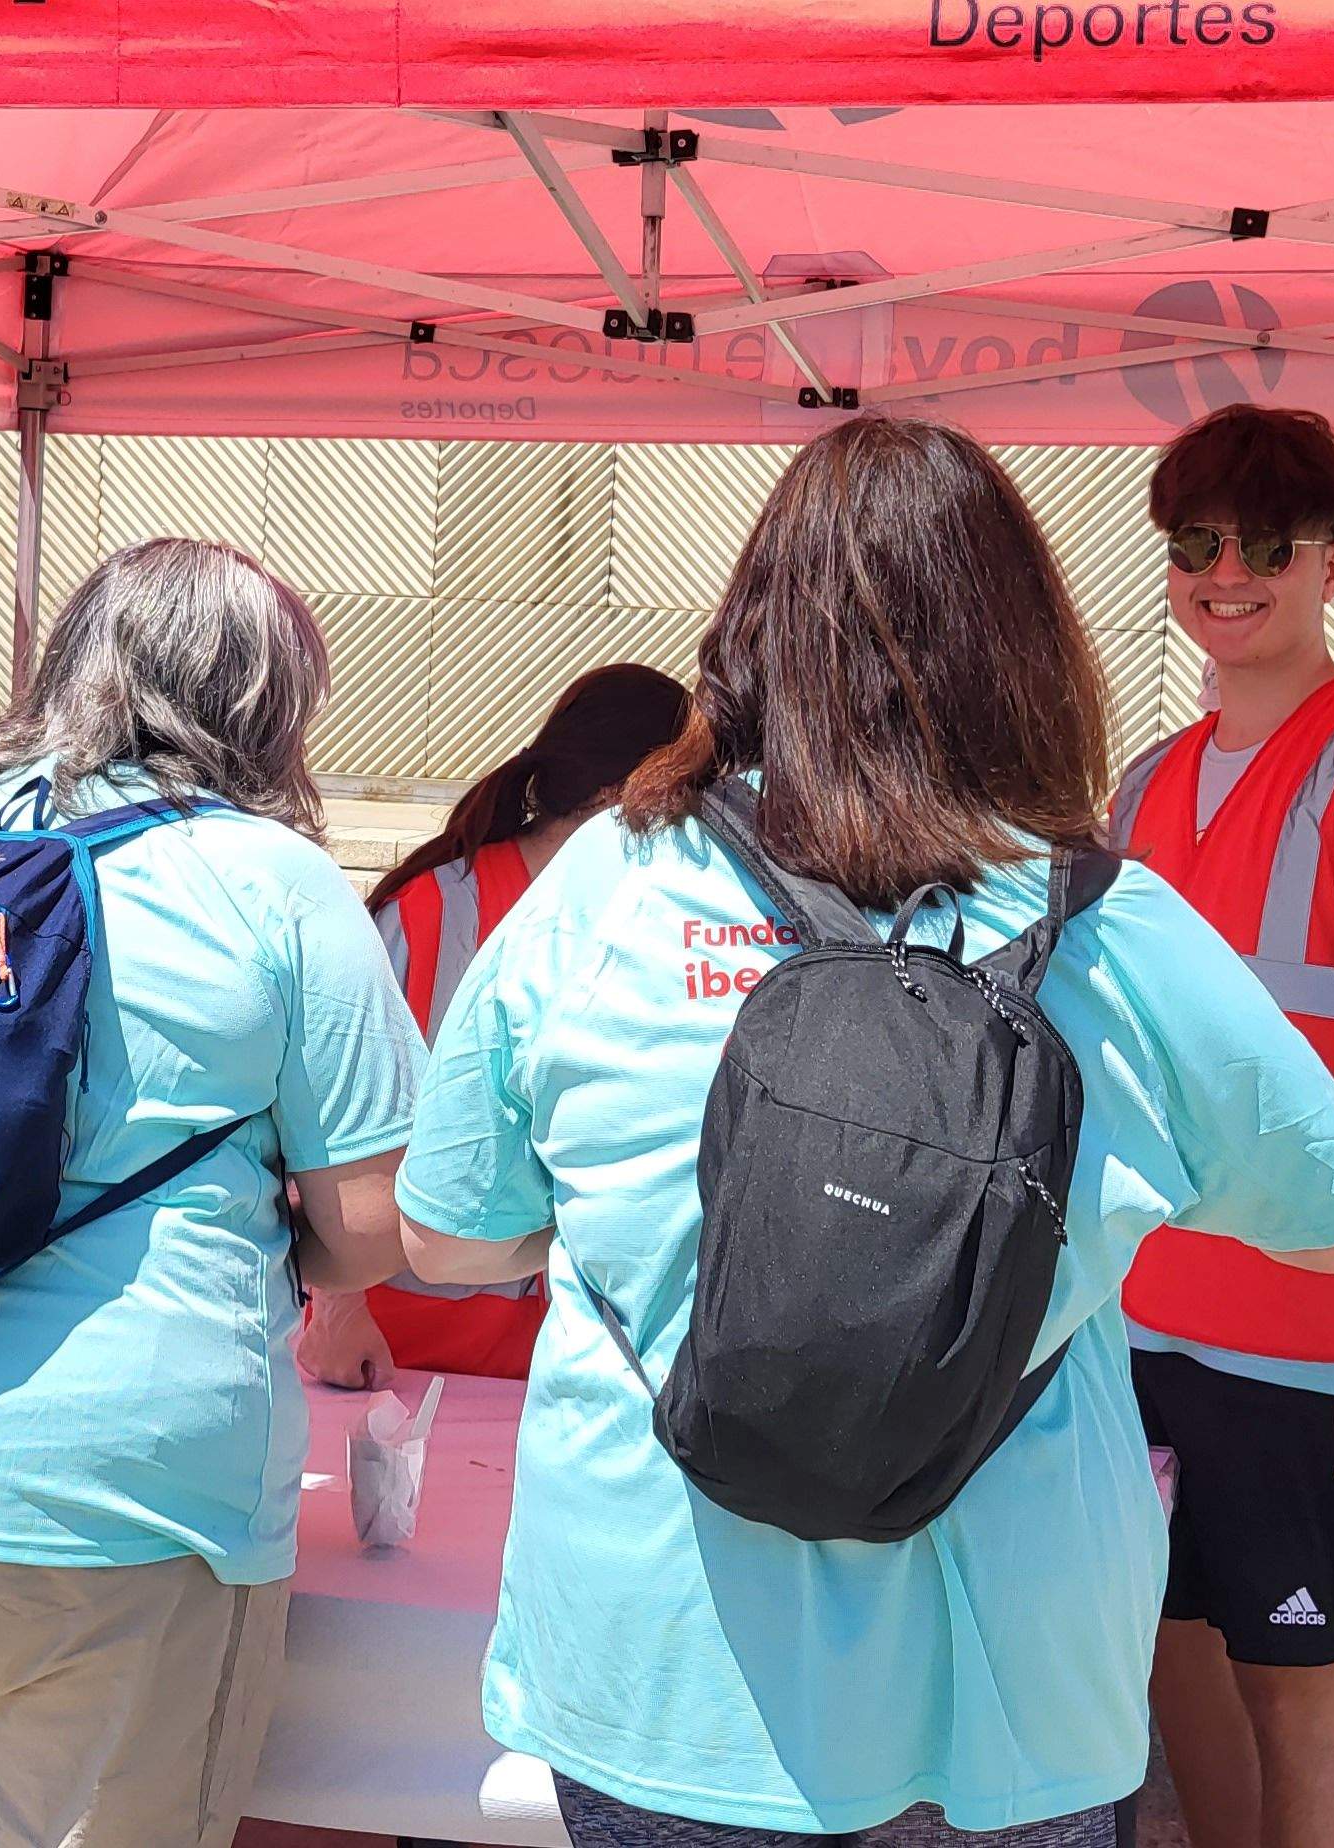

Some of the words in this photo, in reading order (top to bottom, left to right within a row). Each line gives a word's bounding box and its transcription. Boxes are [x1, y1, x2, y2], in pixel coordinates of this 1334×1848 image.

[929, 0, 1277, 62] Deportes
[823, 1183, 891, 1216] QUECHUA
[1269, 1610, 1327, 1626] adidas
